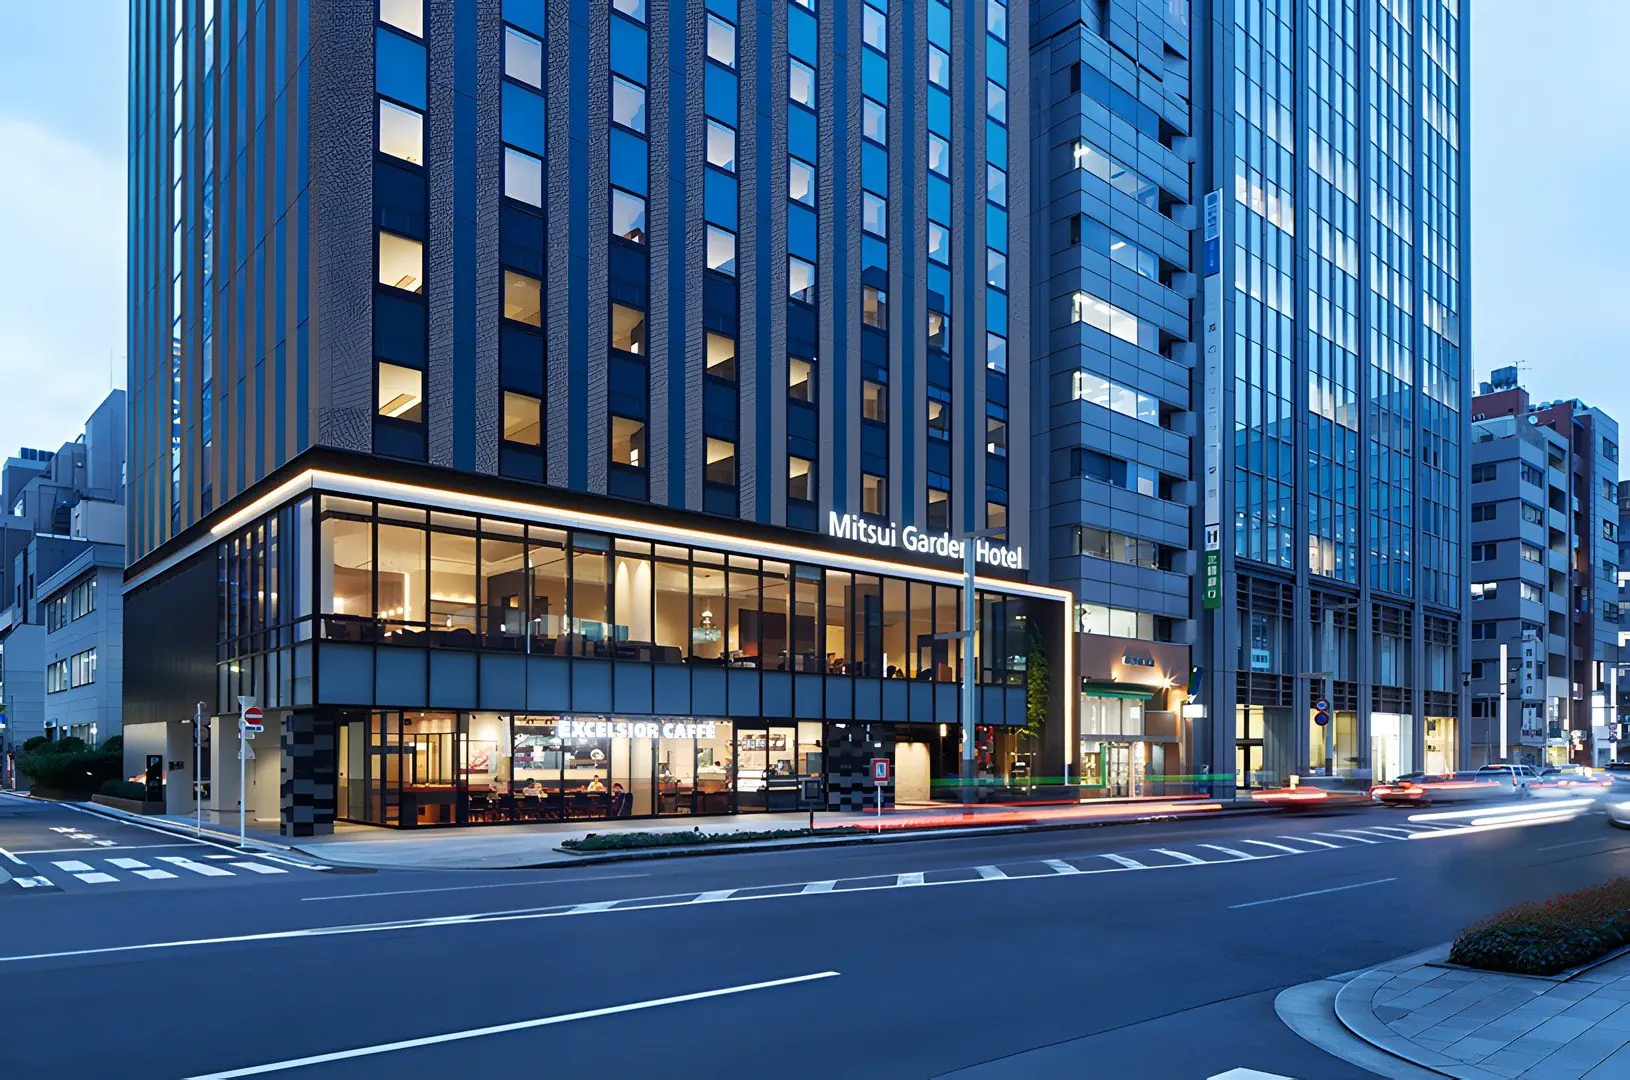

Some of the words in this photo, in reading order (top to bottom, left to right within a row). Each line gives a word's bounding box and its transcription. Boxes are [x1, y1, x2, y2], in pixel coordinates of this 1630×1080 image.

[829, 511, 896, 547] Mitsui
[976, 540, 1022, 570] Hotel
[557, 719, 659, 738] EXCELSIOR
